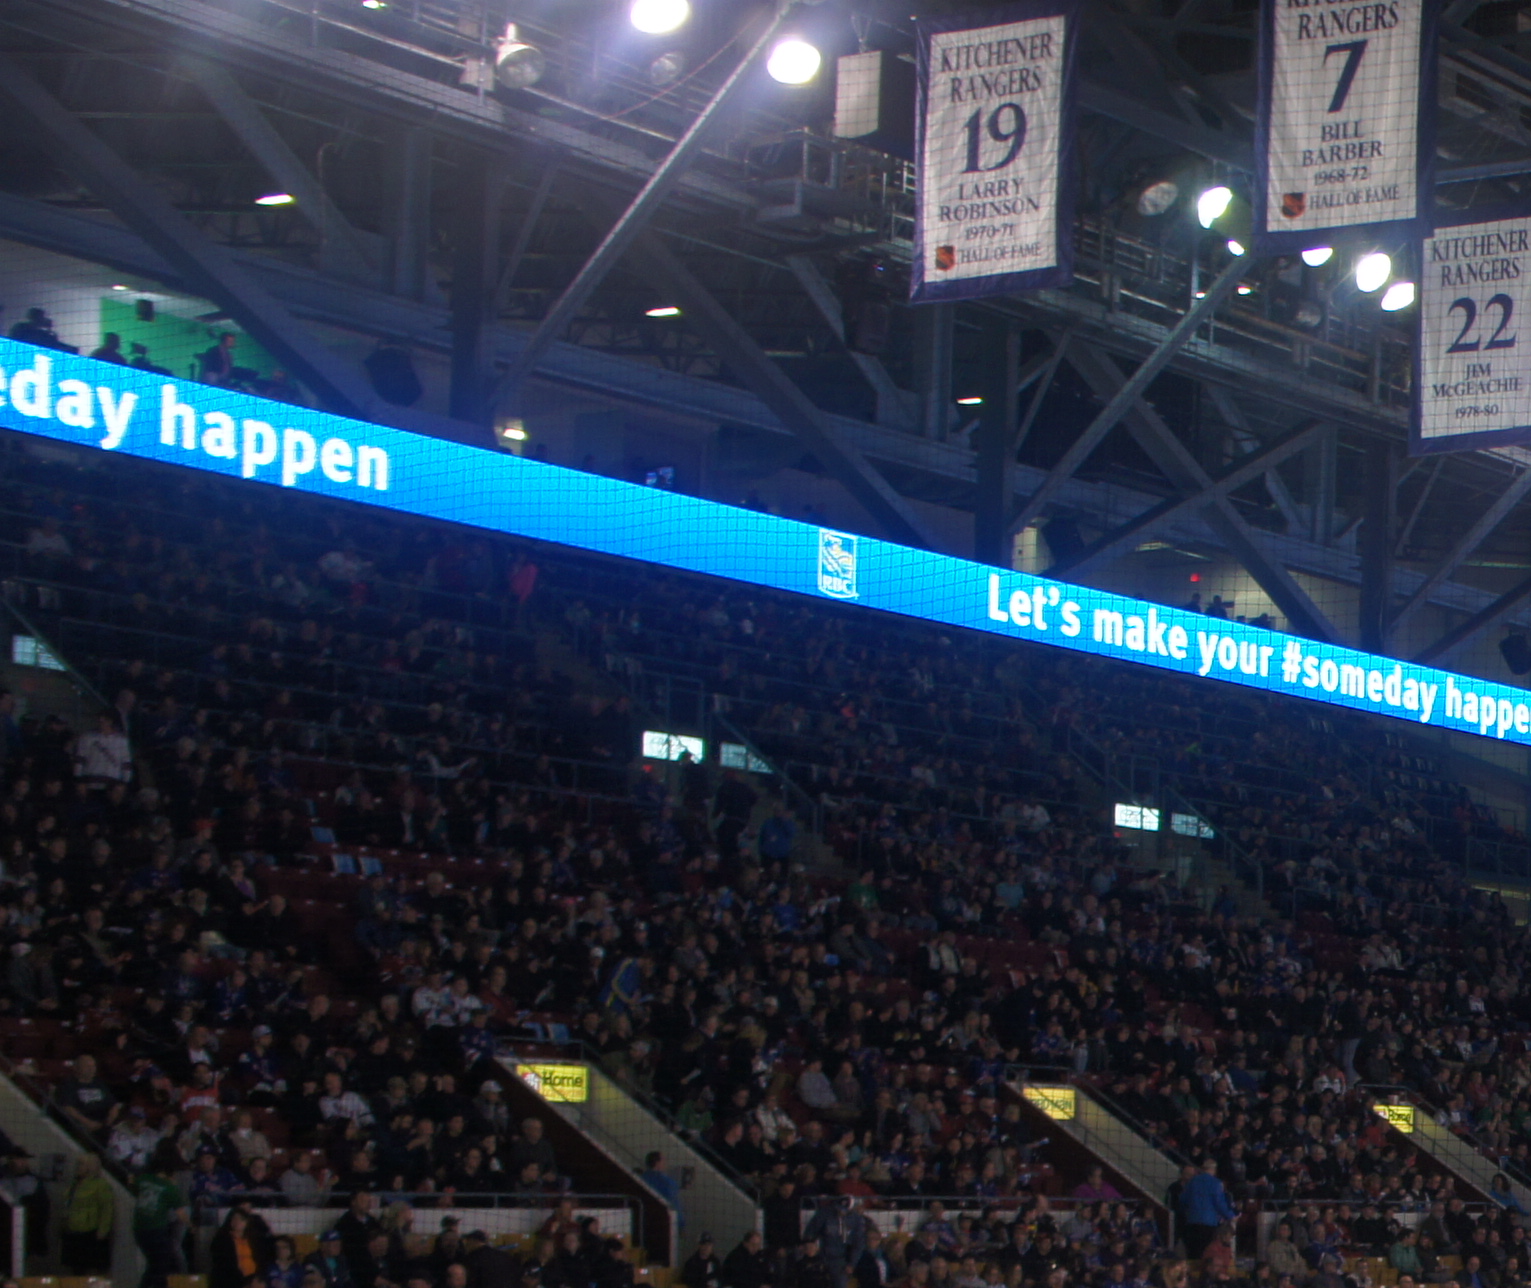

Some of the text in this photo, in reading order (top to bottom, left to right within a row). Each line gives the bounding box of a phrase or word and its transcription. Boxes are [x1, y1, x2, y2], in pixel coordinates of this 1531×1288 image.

[1298, 2, 1399, 40] RANGERS
[941, 32, 1052, 72] KITCHENER
[951, 65, 1042, 103] RANGERS
[1323, 40, 1368, 113] 7
[962, 102, 1027, 174] 19
[1321, 120, 1365, 143] BILL
[1302, 141, 1384, 167] BARBER
[959, 178, 1024, 200] LARRY
[1314, 166, 1368, 186] 1968-72
[940, 198, 1040, 222] ROBINSON
[1310, 185, 1400, 210] HALL OF FAME
[965, 223, 1014, 241] 1970-71
[1432, 229, 1529, 261] KITCHENER
[961, 241, 1040, 264] HALL OF FAME
[1442, 257, 1520, 286] RANGERS
[1446, 293, 1516, 353] 22
[1455, 404, 1499, 419] 1978-80
[160, 383, 389, 491] happen
[987, 573, 1080, 637] Let's
[1094, 608, 1187, 659] make
[1200, 630, 1273, 676] your
[1282, 640, 1437, 723] #someday
[542, 1072, 583, 1088] Home
